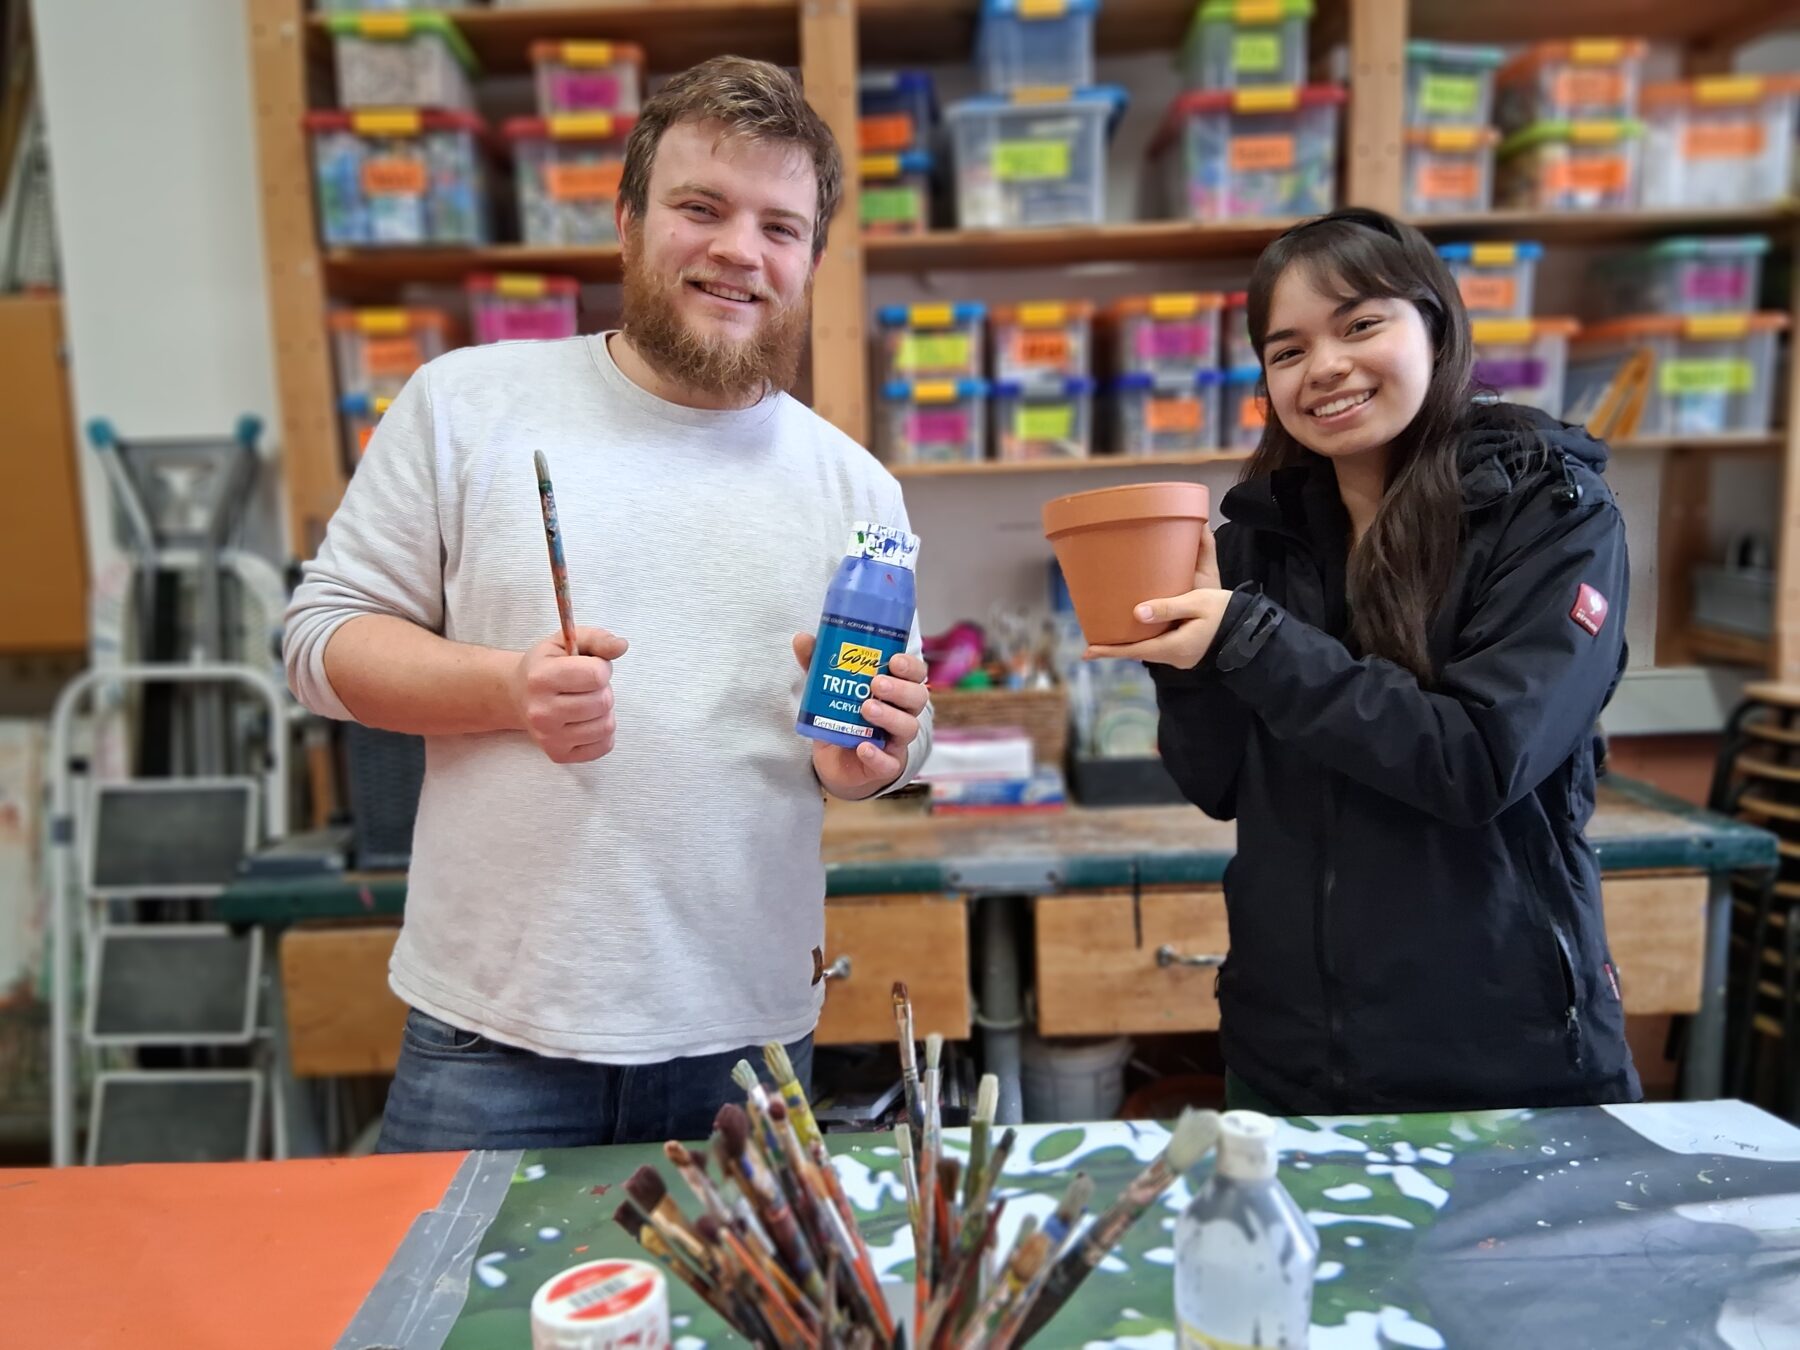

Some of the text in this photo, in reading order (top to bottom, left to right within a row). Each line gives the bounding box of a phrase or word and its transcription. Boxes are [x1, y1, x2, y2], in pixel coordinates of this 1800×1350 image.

[830, 648, 884, 676] Goya
[861, 649, 879, 659] SOLO
[823, 674, 873, 699] TRITO
[829, 699, 861, 714] ACRYLI
[814, 717, 864, 736] Gerstaecker
